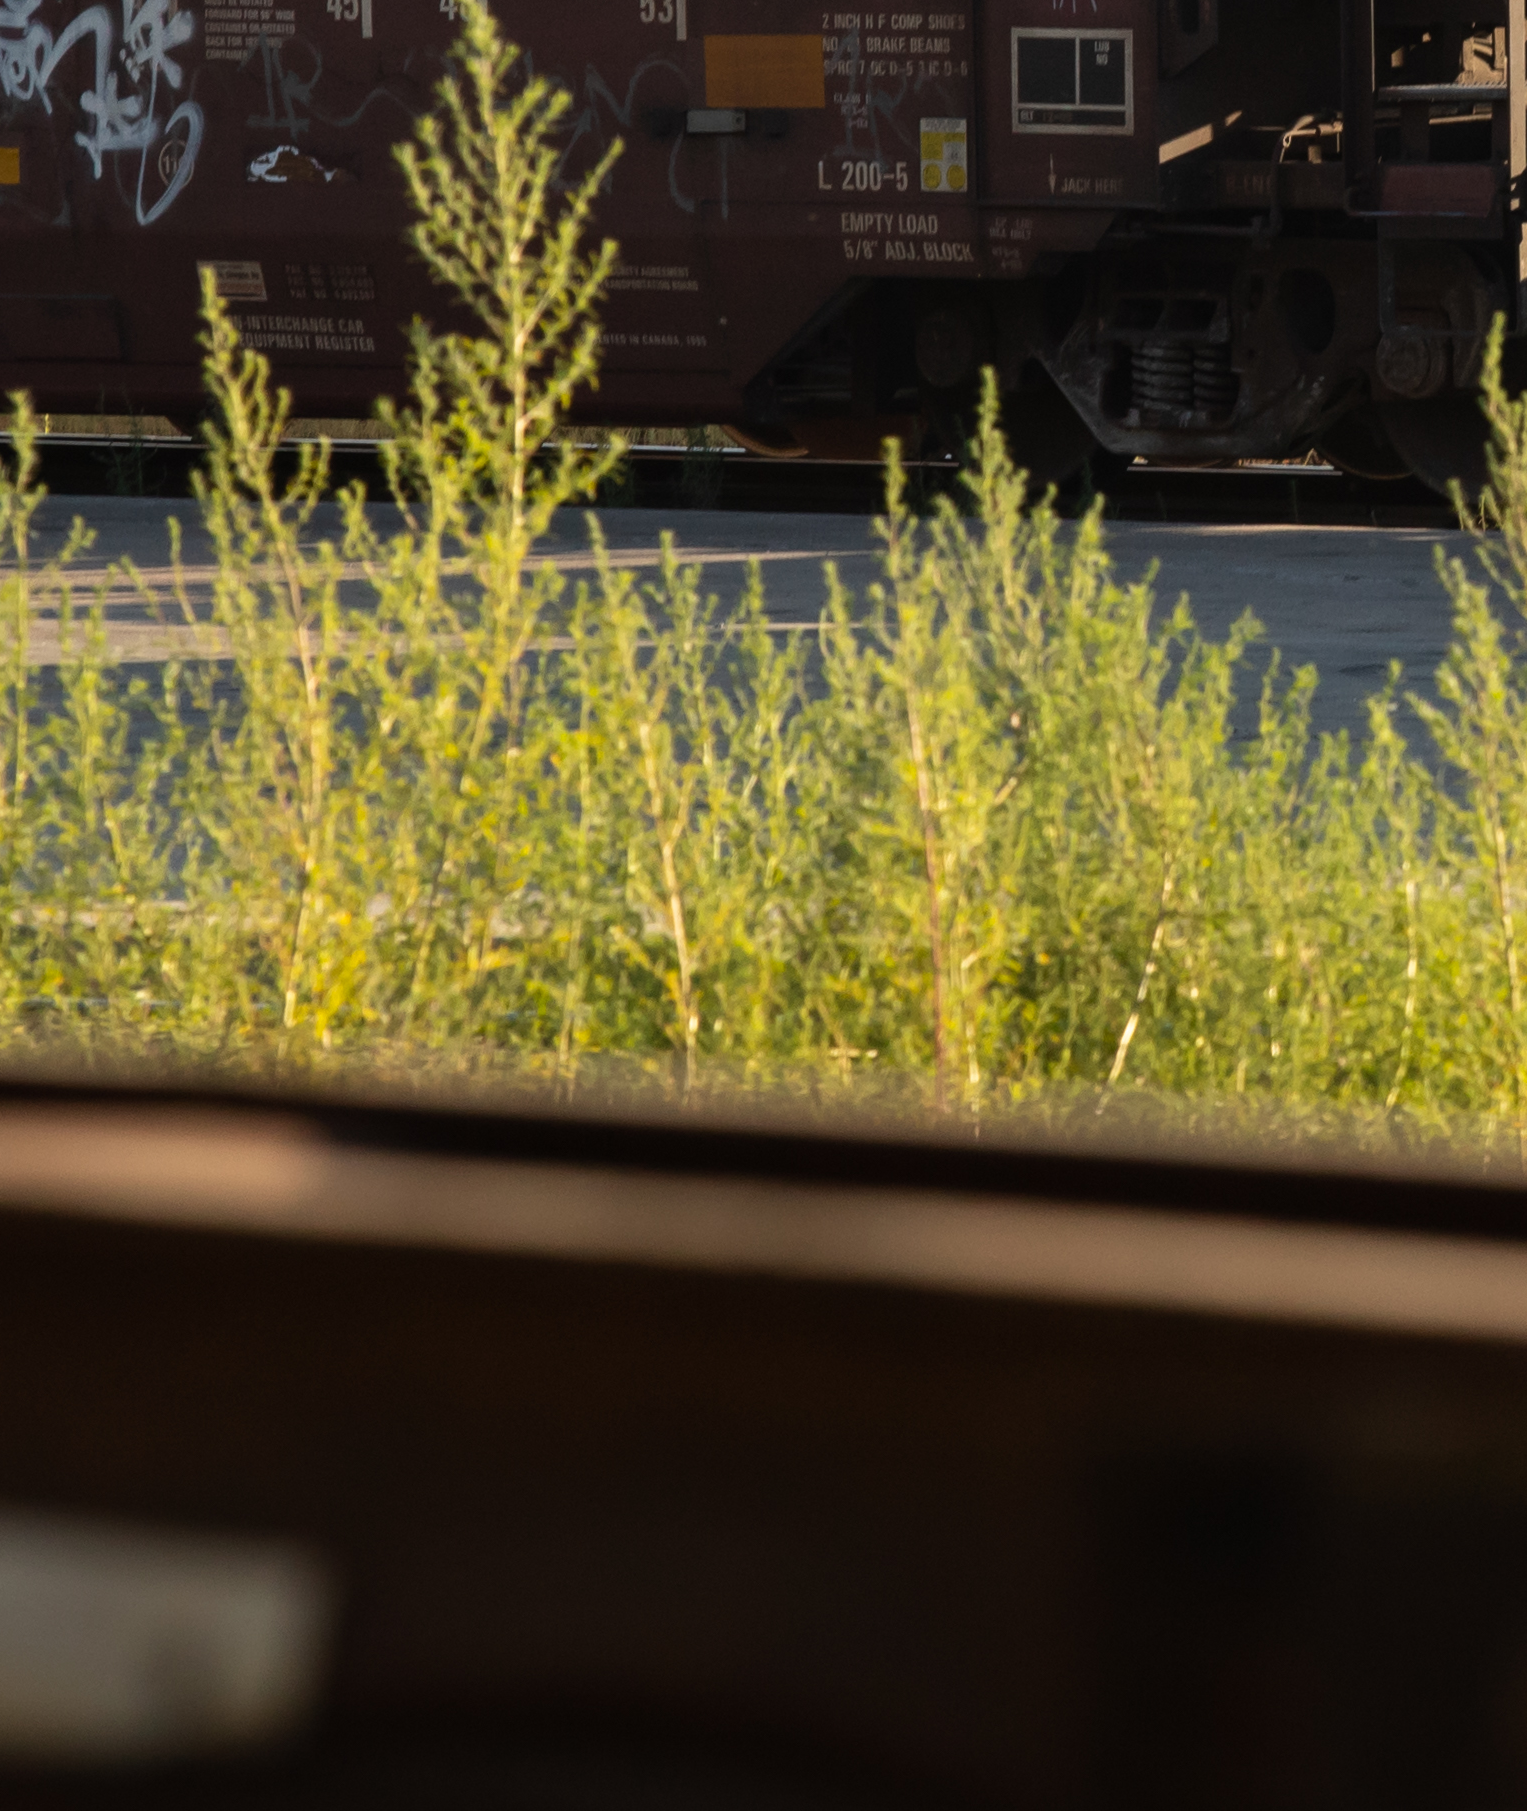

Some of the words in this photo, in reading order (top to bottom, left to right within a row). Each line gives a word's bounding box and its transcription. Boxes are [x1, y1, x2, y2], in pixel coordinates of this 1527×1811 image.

[822, 13, 830, 30] 2
[834, 13, 861, 30] INCH
[865, 13, 874, 30] H
[878, 13, 886, 30] F
[891, 14, 923, 30] COMP
[927, 14, 966, 31] SHOES
[866, 36, 906, 53] BRAKE
[910, 37, 951, 54] BEAMS
[818, 160, 833, 190] L
[841, 160, 909, 192] 200-5
[1062, 177, 1091, 194] JACK
[841, 212, 893, 234] EMPTY
[898, 213, 939, 234] LOAD
[885, 241, 921, 261] ADJ.
[924, 242, 974, 263] BLOCK
[338, 318, 365, 335] CAR
[315, 335, 375, 353] REGISTER
